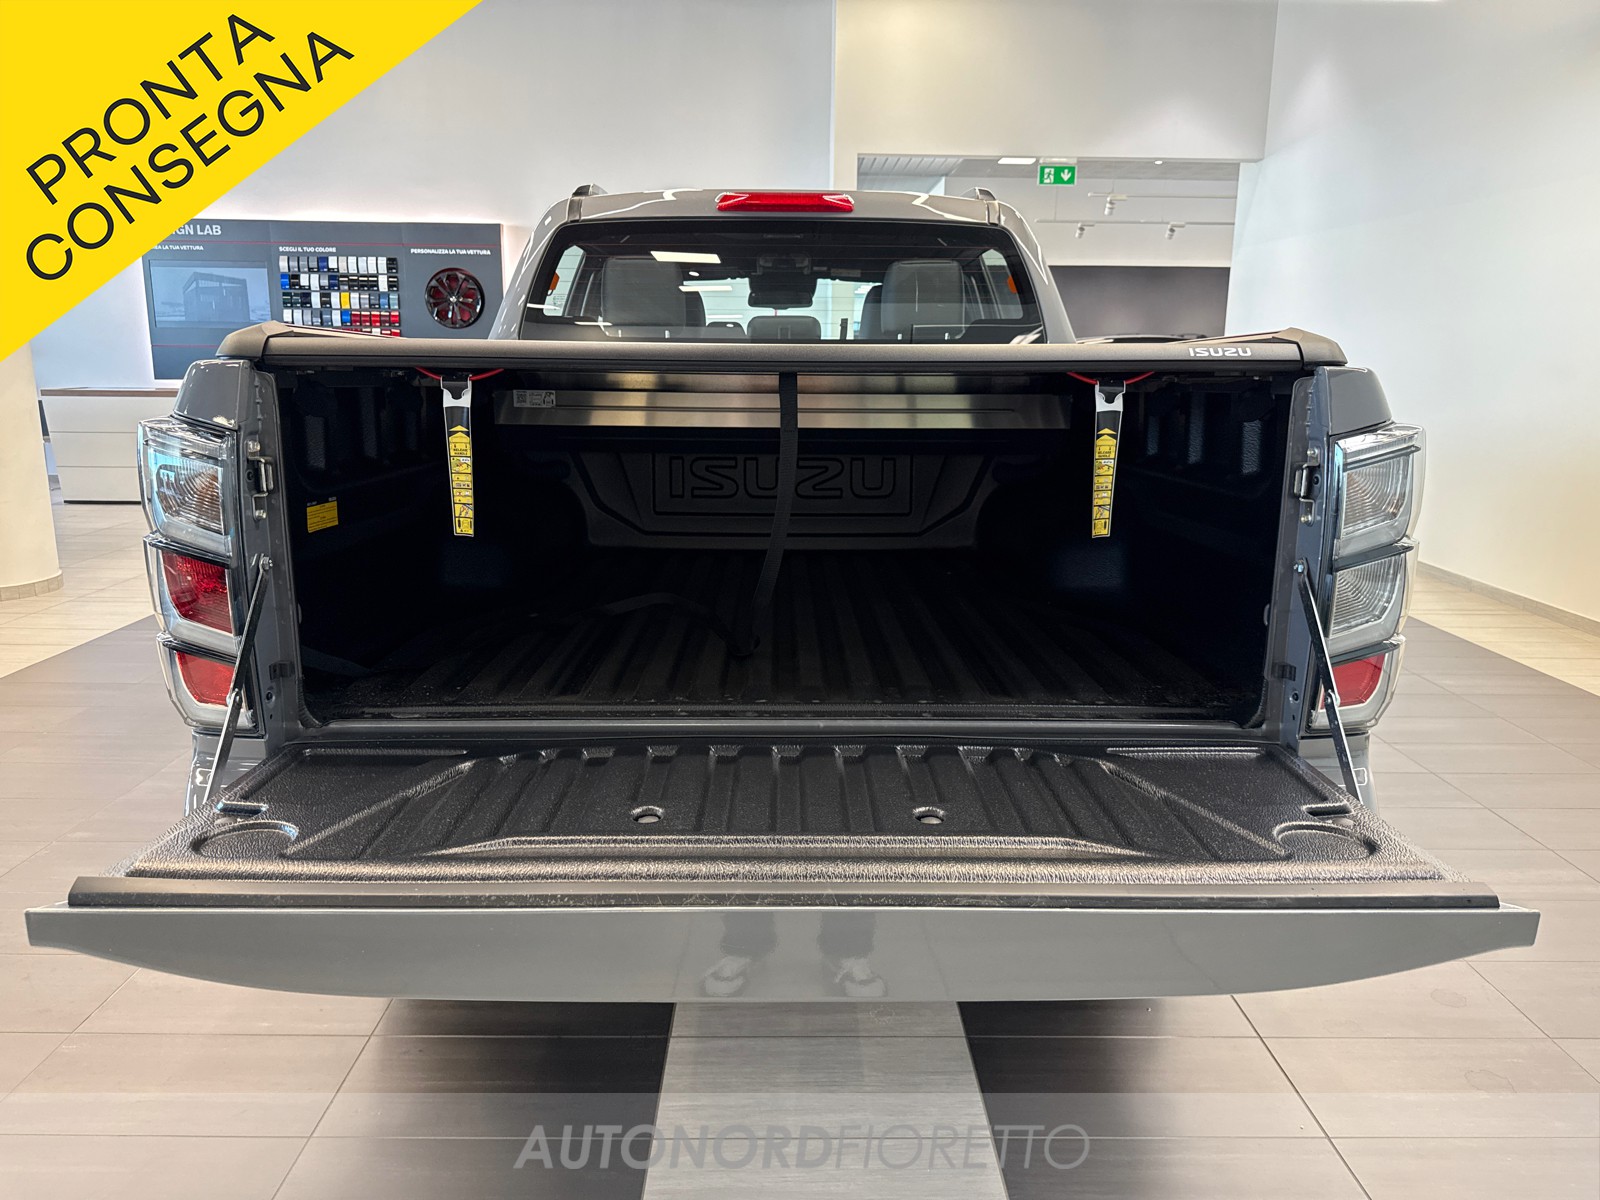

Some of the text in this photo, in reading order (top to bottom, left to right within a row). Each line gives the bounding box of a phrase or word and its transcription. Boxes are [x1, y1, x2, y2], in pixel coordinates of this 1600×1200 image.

[197, 225, 221, 235] LAB
[1188, 347, 1252, 357] ISUZU
[669, 456, 896, 499] ISUZU
